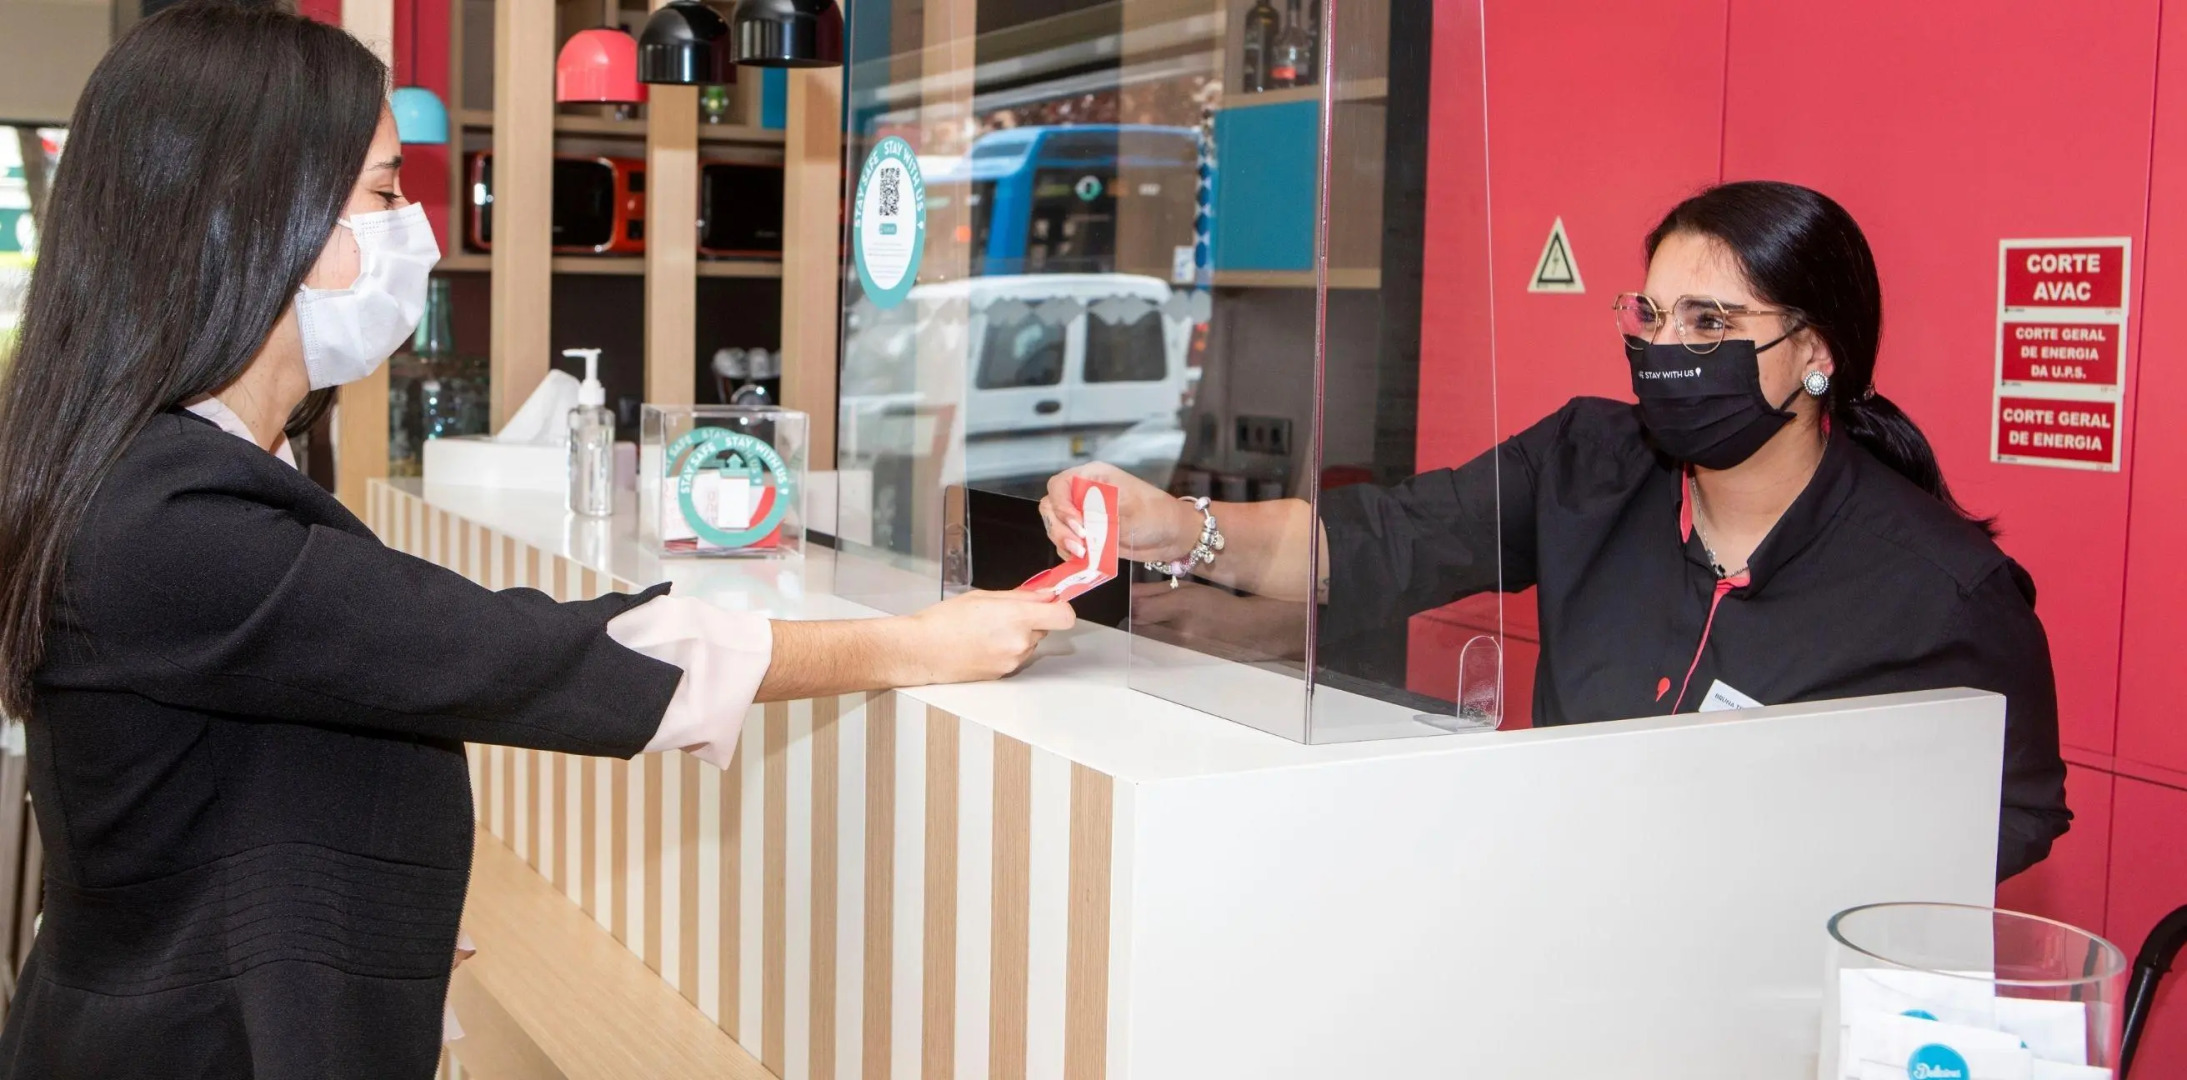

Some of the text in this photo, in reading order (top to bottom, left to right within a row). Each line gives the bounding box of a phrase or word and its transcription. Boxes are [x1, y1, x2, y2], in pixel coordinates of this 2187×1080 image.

[855, 140, 924, 227] STAY SAFE STAY WITH US
[2026, 253, 2101, 274] CORTE
[2033, 281, 2092, 301] AVAC
[2015, 327, 2106, 342] CORTE GERAL
[2021, 345, 2099, 360] DE ENERGIA
[1645, 371, 1660, 379] STAY
[1662, 370, 1682, 379] WITH
[1684, 369, 1694, 377] US
[2031, 364, 2087, 379] DA U.P.S.
[2003, 408, 2111, 429] CORTE GERAL
[2009, 430, 2103, 450] DE ENERGIA
[680, 465, 694, 494] STAY
[690, 442, 716, 467] SAFE
[725, 436, 754, 449] STAY
[755, 441, 782, 469] WITH
[776, 467, 788, 484] US
